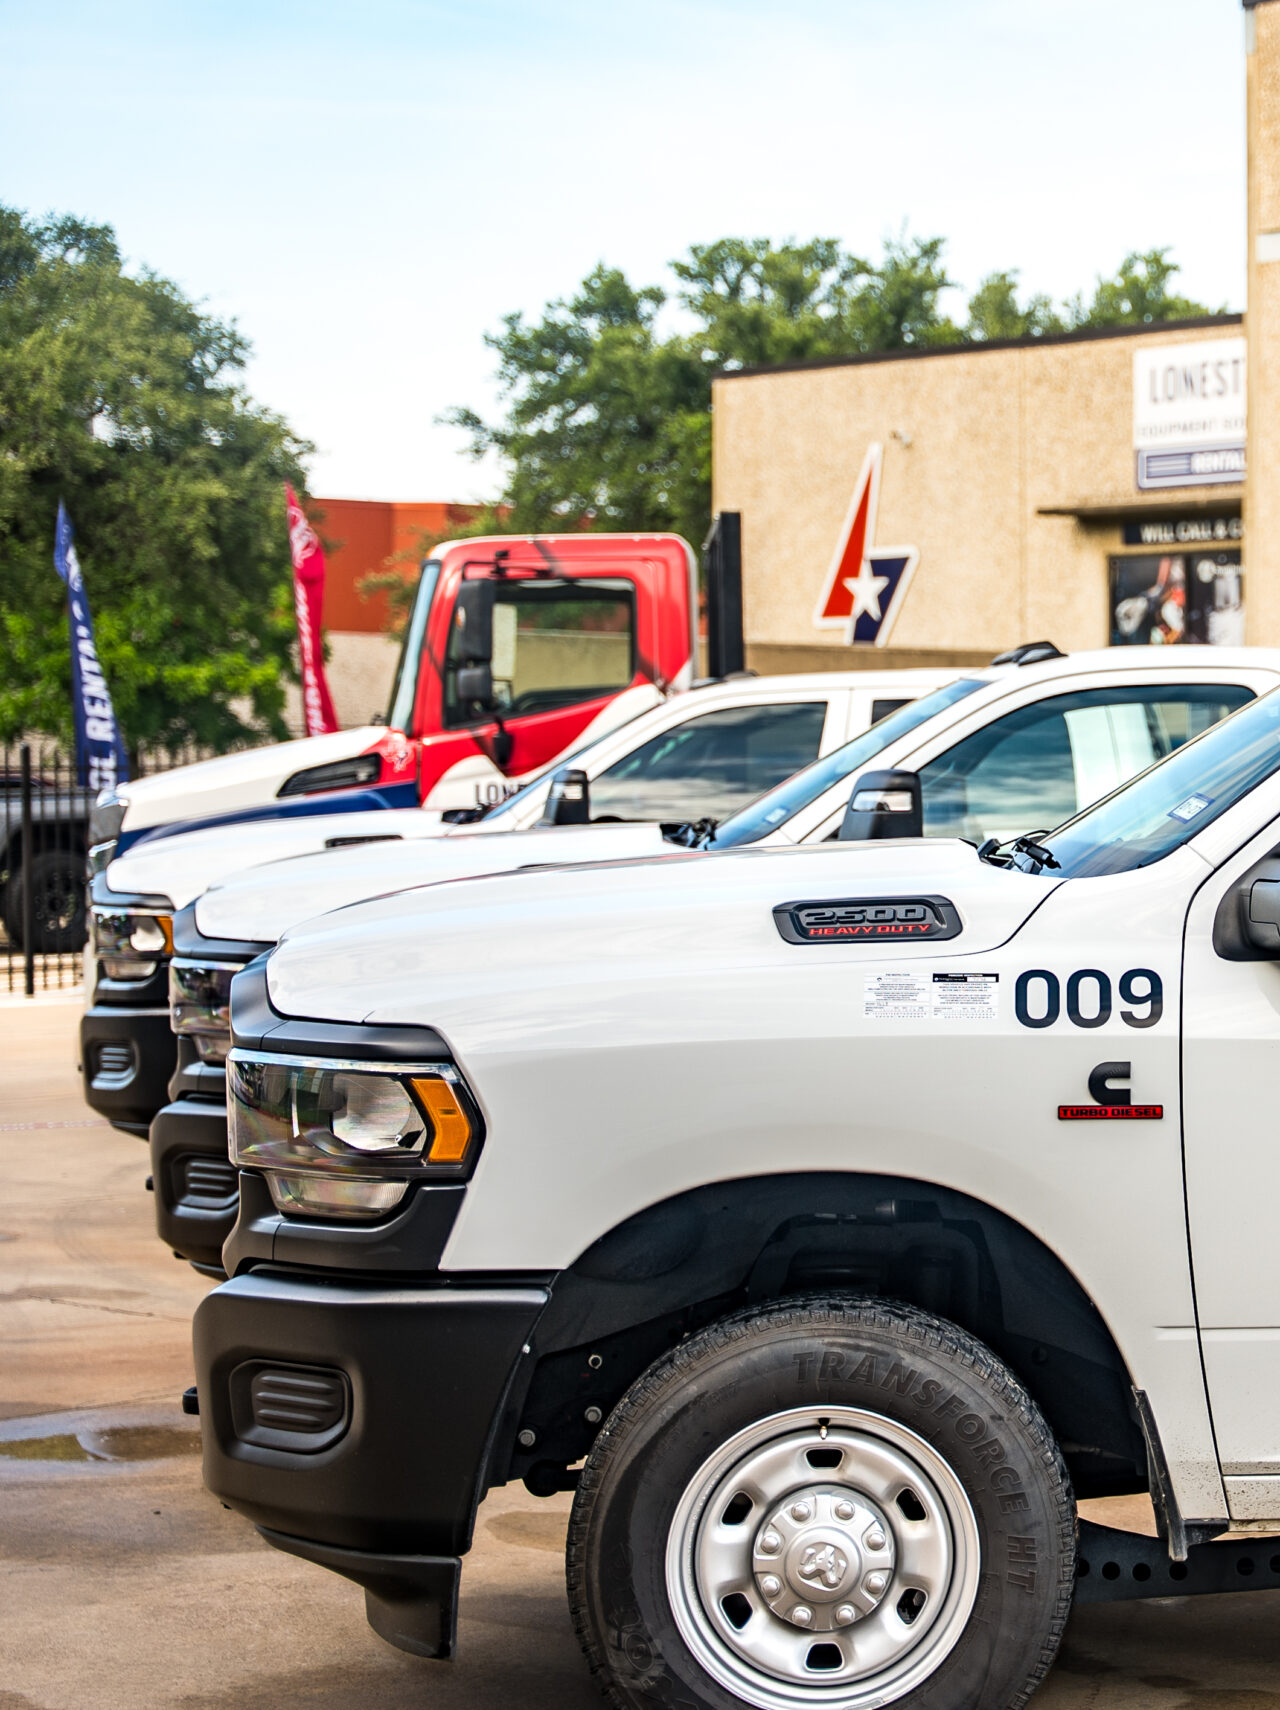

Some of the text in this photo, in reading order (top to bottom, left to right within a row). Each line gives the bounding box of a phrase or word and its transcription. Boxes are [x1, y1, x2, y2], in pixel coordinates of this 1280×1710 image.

[1140, 522, 1175, 544] WILL
[1176, 520, 1212, 542] CALL
[804, 906, 927, 926] 2500
[809, 924, 931, 936] HEAVY DUTY
[1014, 968, 1164, 1029] 009
[1061, 1108, 1161, 1117] TURBO DIESEL
[792, 1350, 1039, 1595] TRANSFORCE HT
